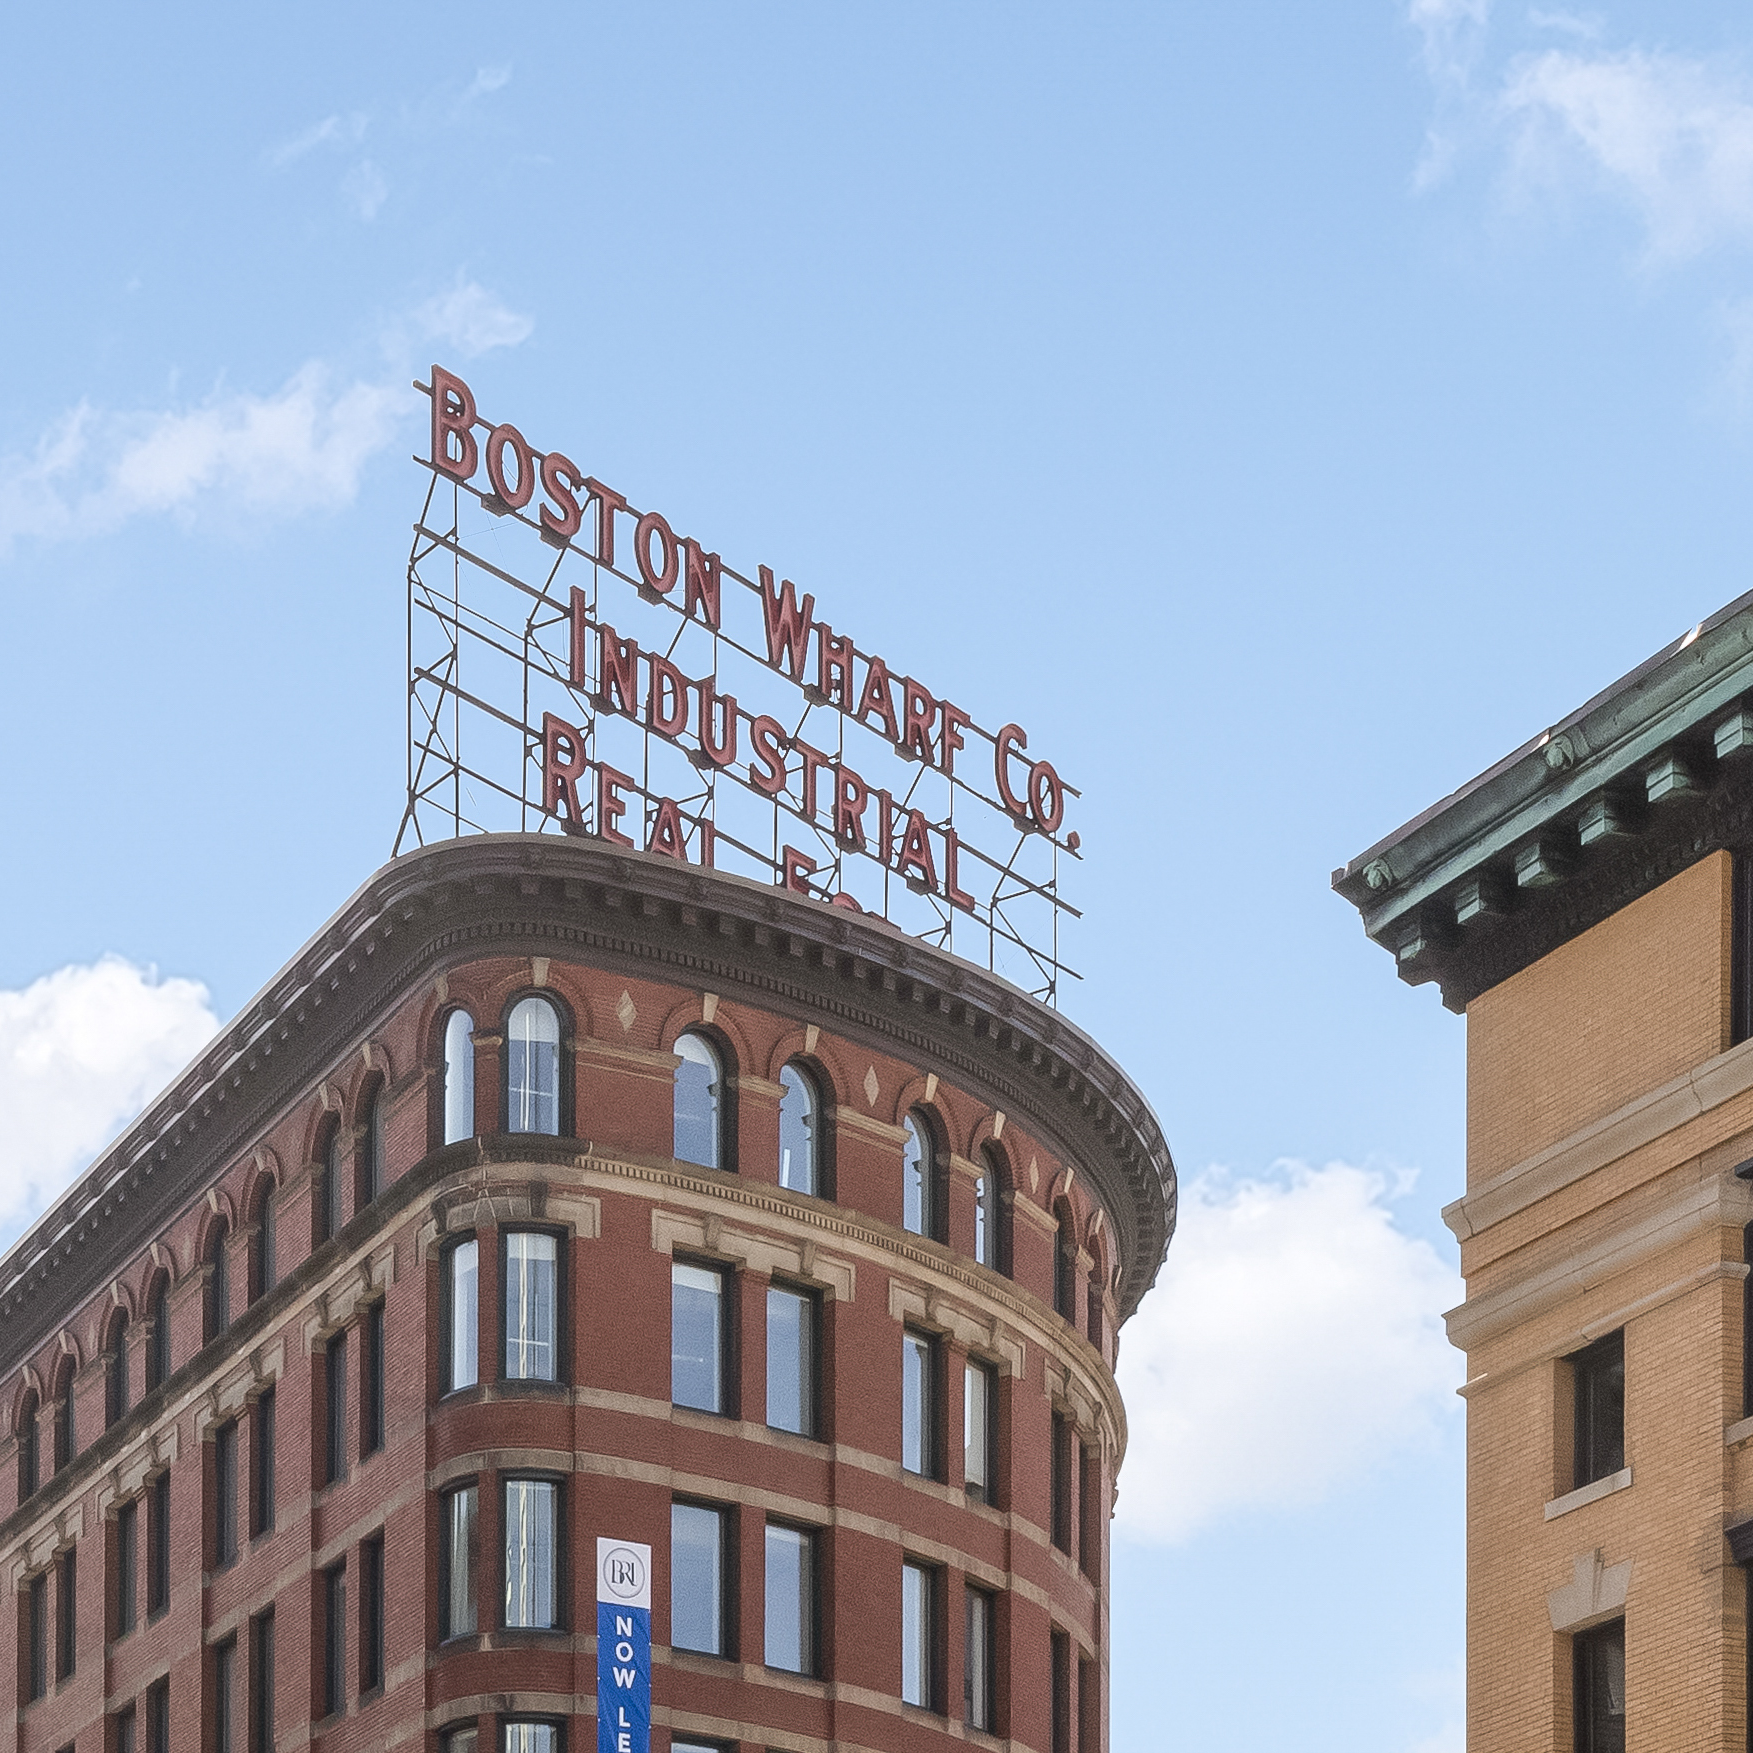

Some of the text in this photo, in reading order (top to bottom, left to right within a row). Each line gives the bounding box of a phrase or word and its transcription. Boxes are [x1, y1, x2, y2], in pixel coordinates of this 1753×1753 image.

[431, 364, 721, 630] BOSTON
[757, 564, 972, 774] WHARF
[570, 585, 975, 913] INDUSTRIAL
[613, 1615, 636, 1690] NOW
